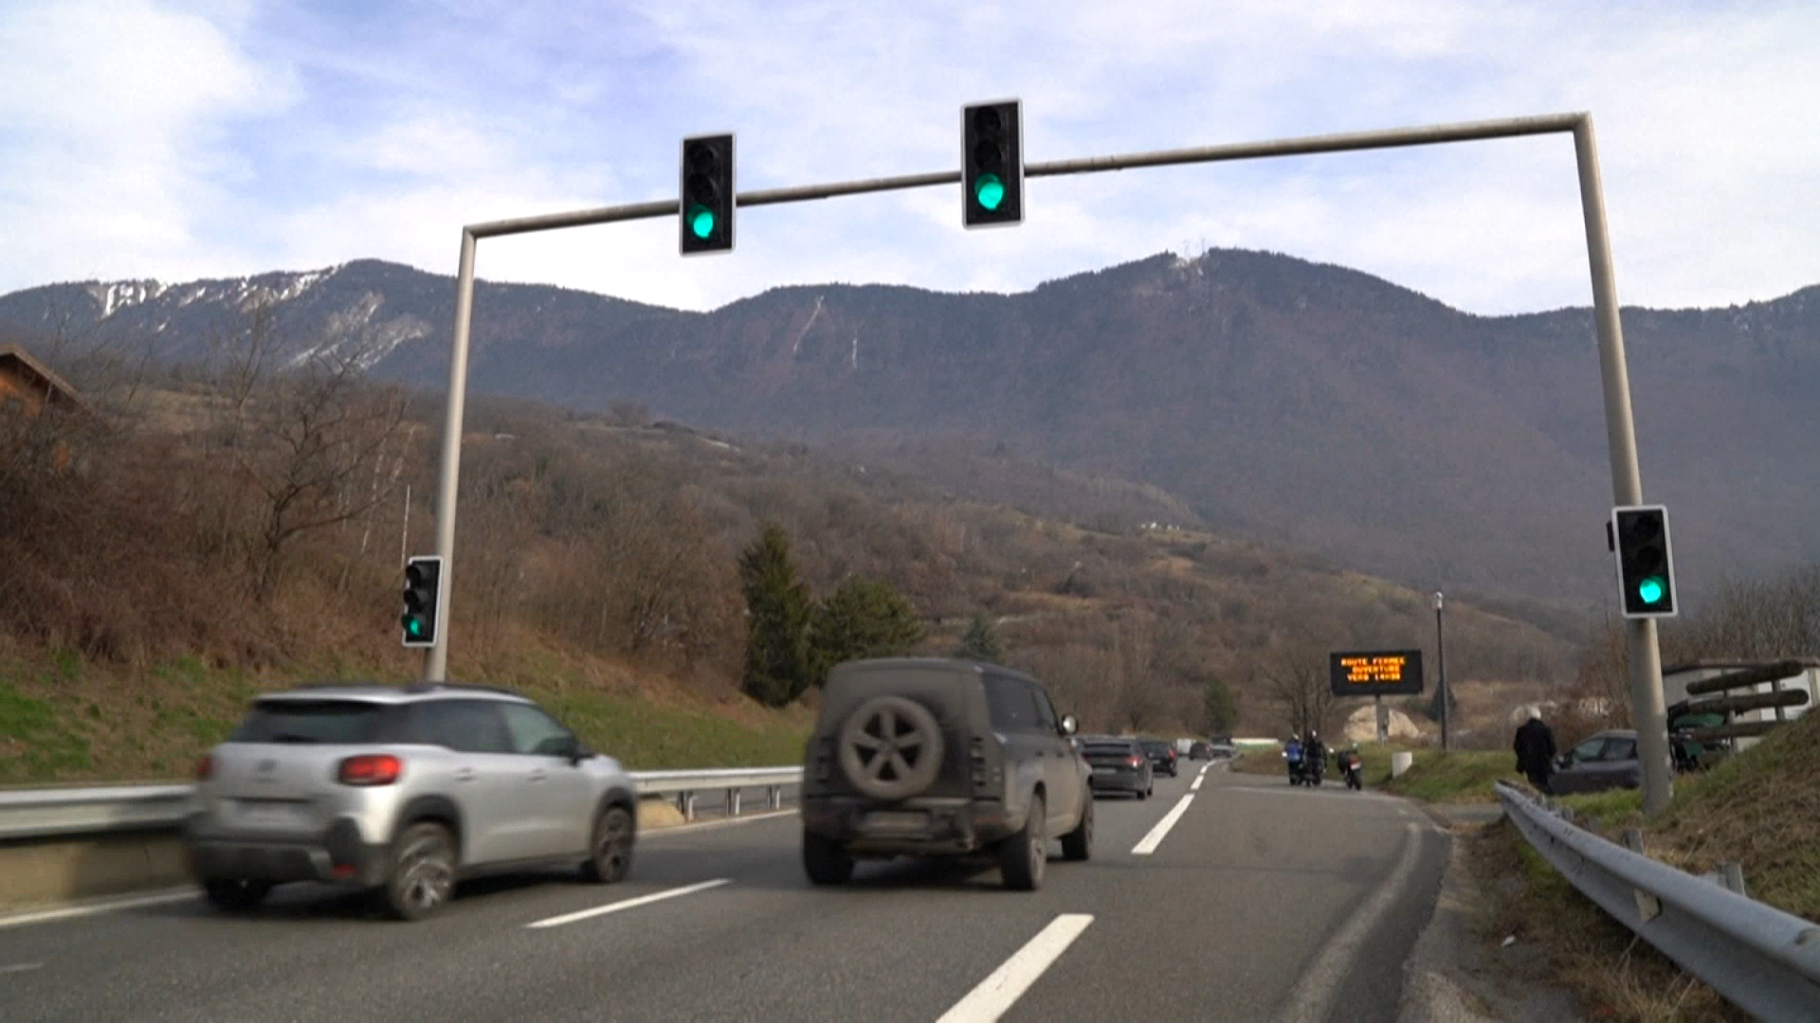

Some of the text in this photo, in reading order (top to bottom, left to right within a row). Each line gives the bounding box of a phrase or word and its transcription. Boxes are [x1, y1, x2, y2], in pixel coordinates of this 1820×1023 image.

[1341, 656, 1405, 667] ROUTE FERMEE
[1352, 665, 1400, 674] OUVERTURE
